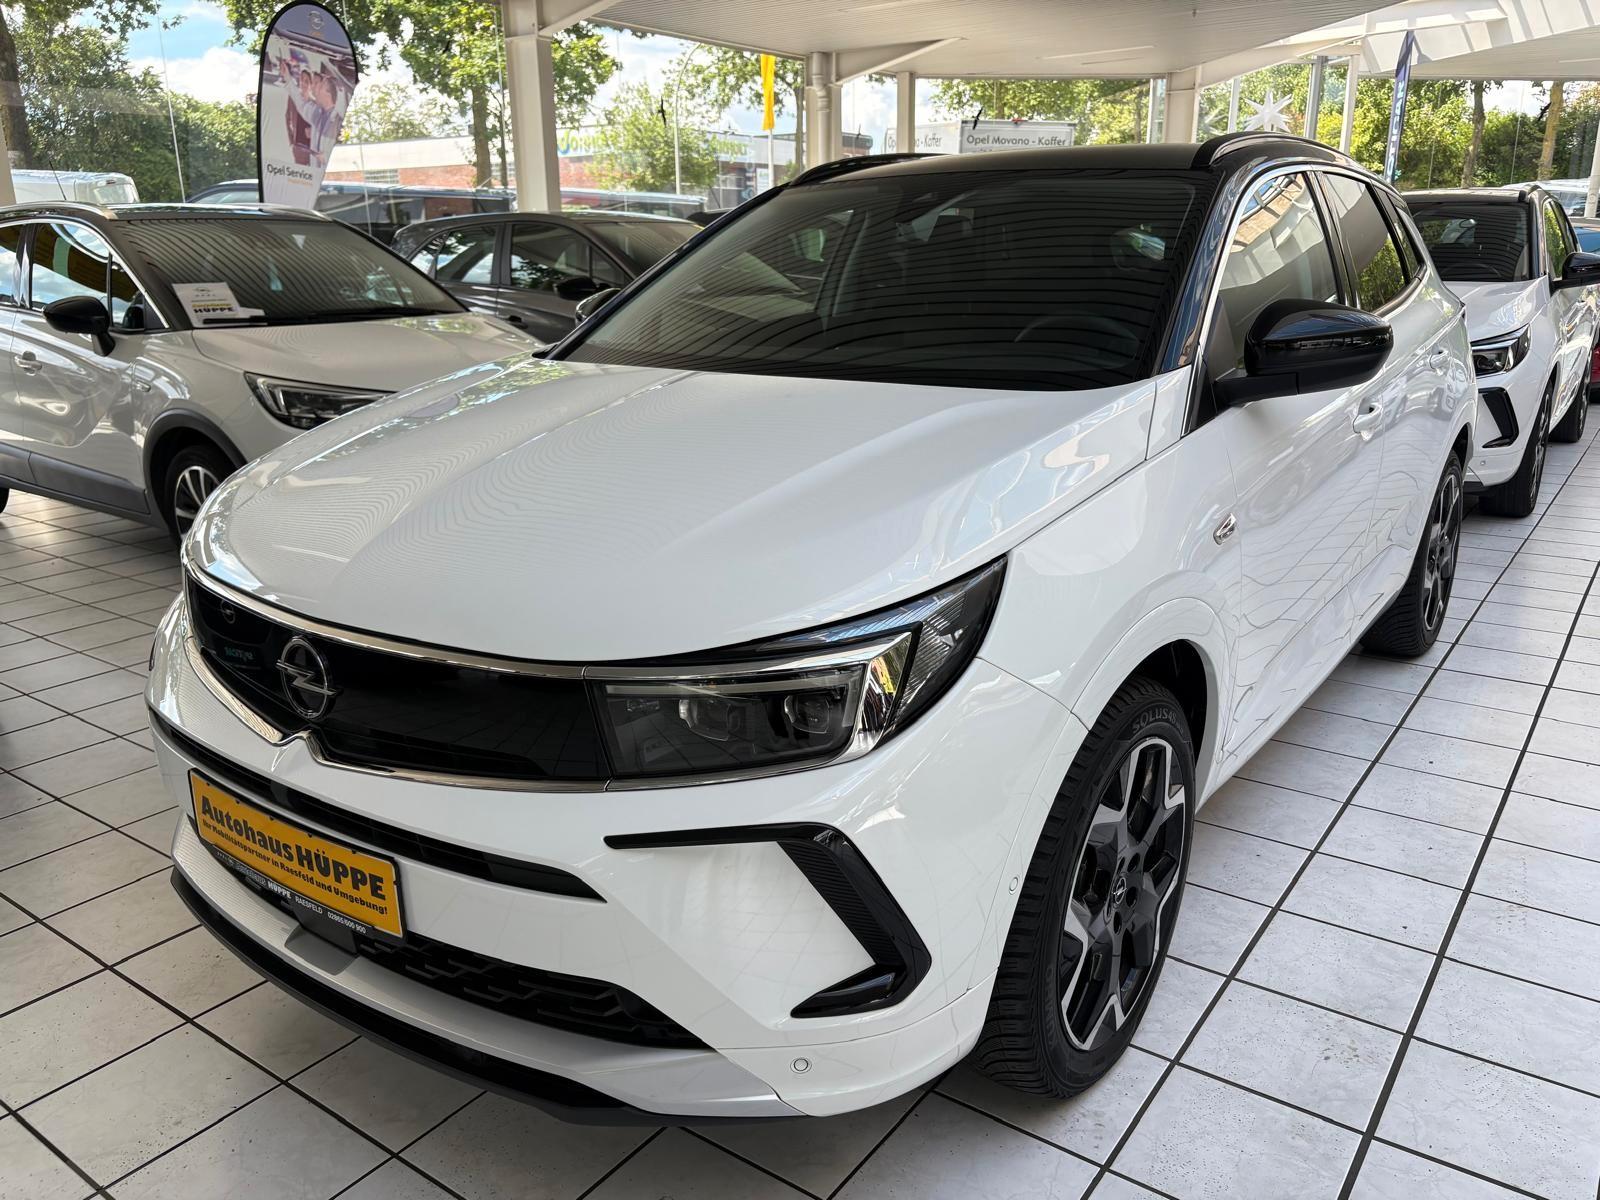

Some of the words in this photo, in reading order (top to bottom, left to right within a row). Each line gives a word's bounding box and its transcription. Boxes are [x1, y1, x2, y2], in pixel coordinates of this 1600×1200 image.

[966, 134, 990, 145] Opel
[991, 136, 1030, 146] Movano
[1038, 135, 1067, 147] Koffer
[266, 163, 286, 177] Opel
[286, 165, 313, 181] Service
[201, 795, 294, 862] Autohaus
[295, 843, 387, 901] HÜPPE
[279, 862, 316, 885] Raesfeld
[315, 880, 333, 894] und
[333, 885, 389, 916] Umgebung!
[294, 895, 324, 914] RAESFELD
